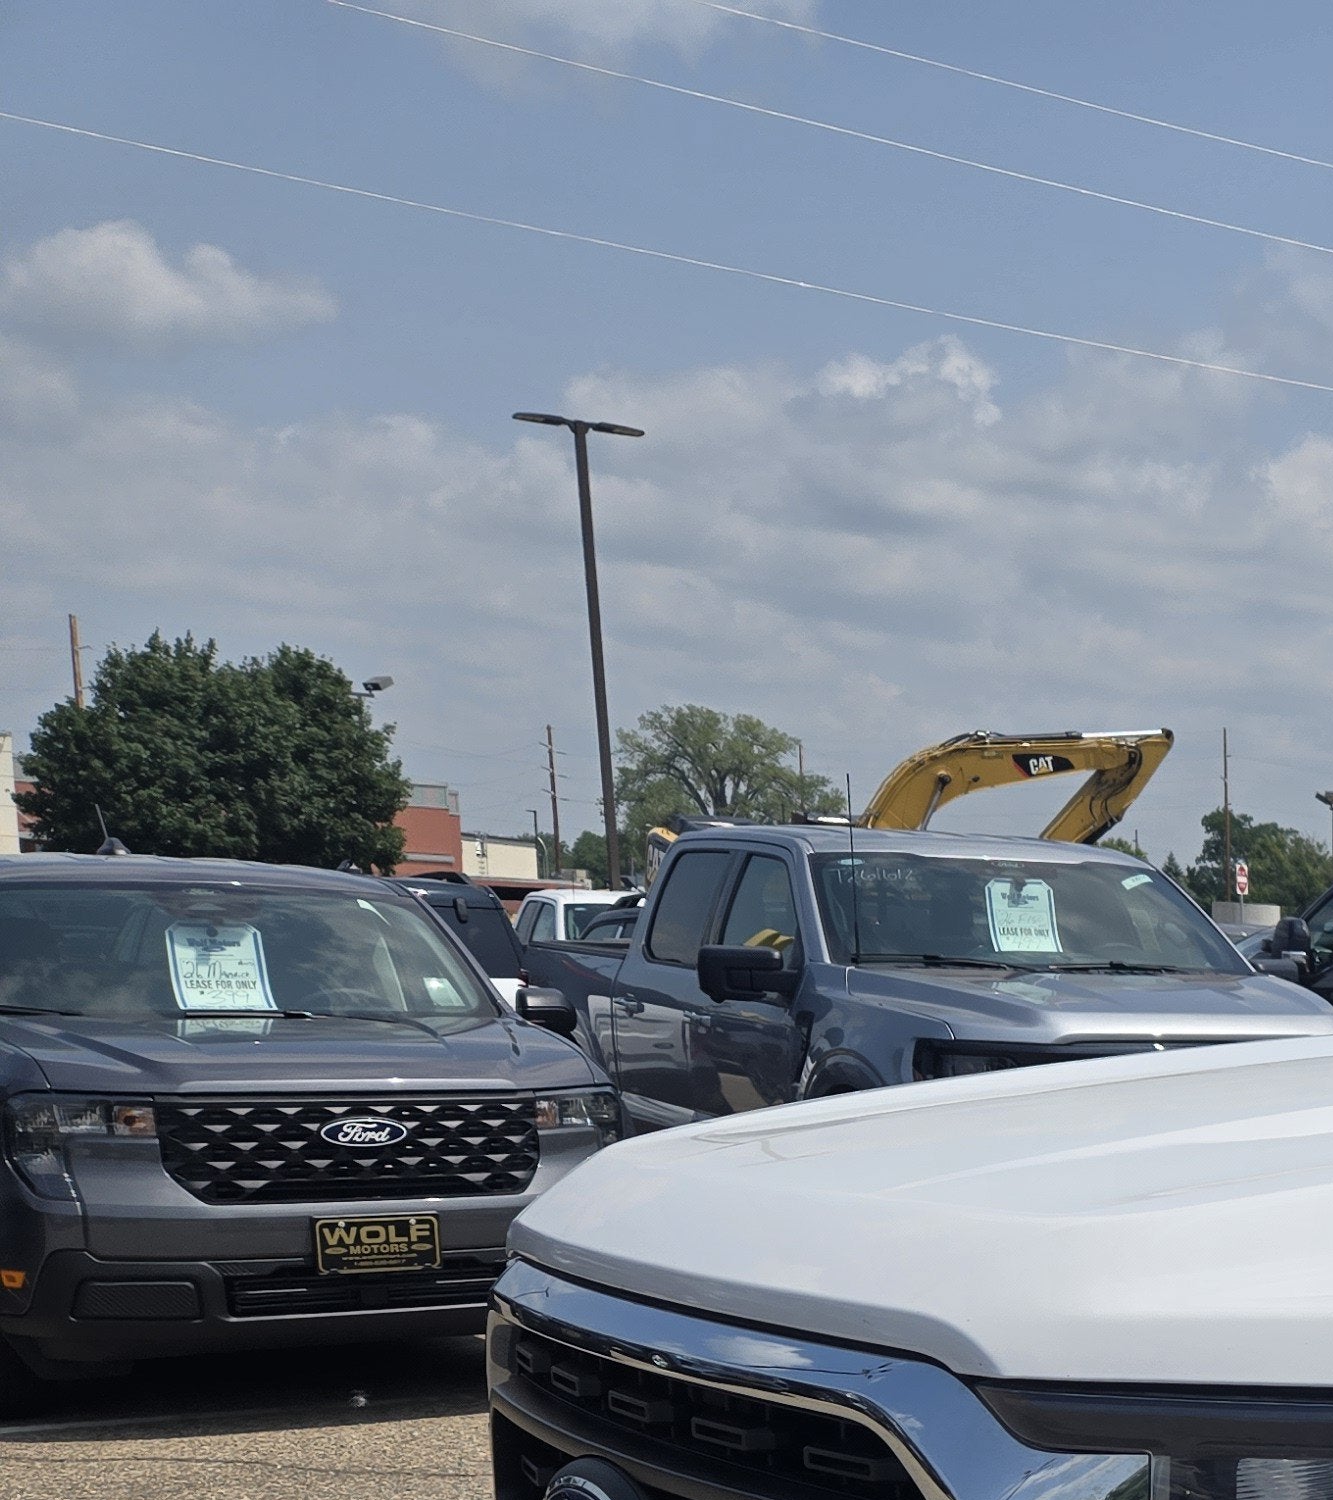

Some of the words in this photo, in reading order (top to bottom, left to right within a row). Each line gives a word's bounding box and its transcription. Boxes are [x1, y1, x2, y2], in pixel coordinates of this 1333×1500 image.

[1029, 756, 1054, 775] CAT
[1020, 928, 1033, 936] FOR
[185, 980, 213, 989] LEASE
[216, 981, 233, 989] FOR
[236, 980, 257, 990] ONLY
[337, 1122, 391, 1142] Ford
[322, 1223, 431, 1246] WOLF
[350, 1243, 409, 1255] MOTORS
